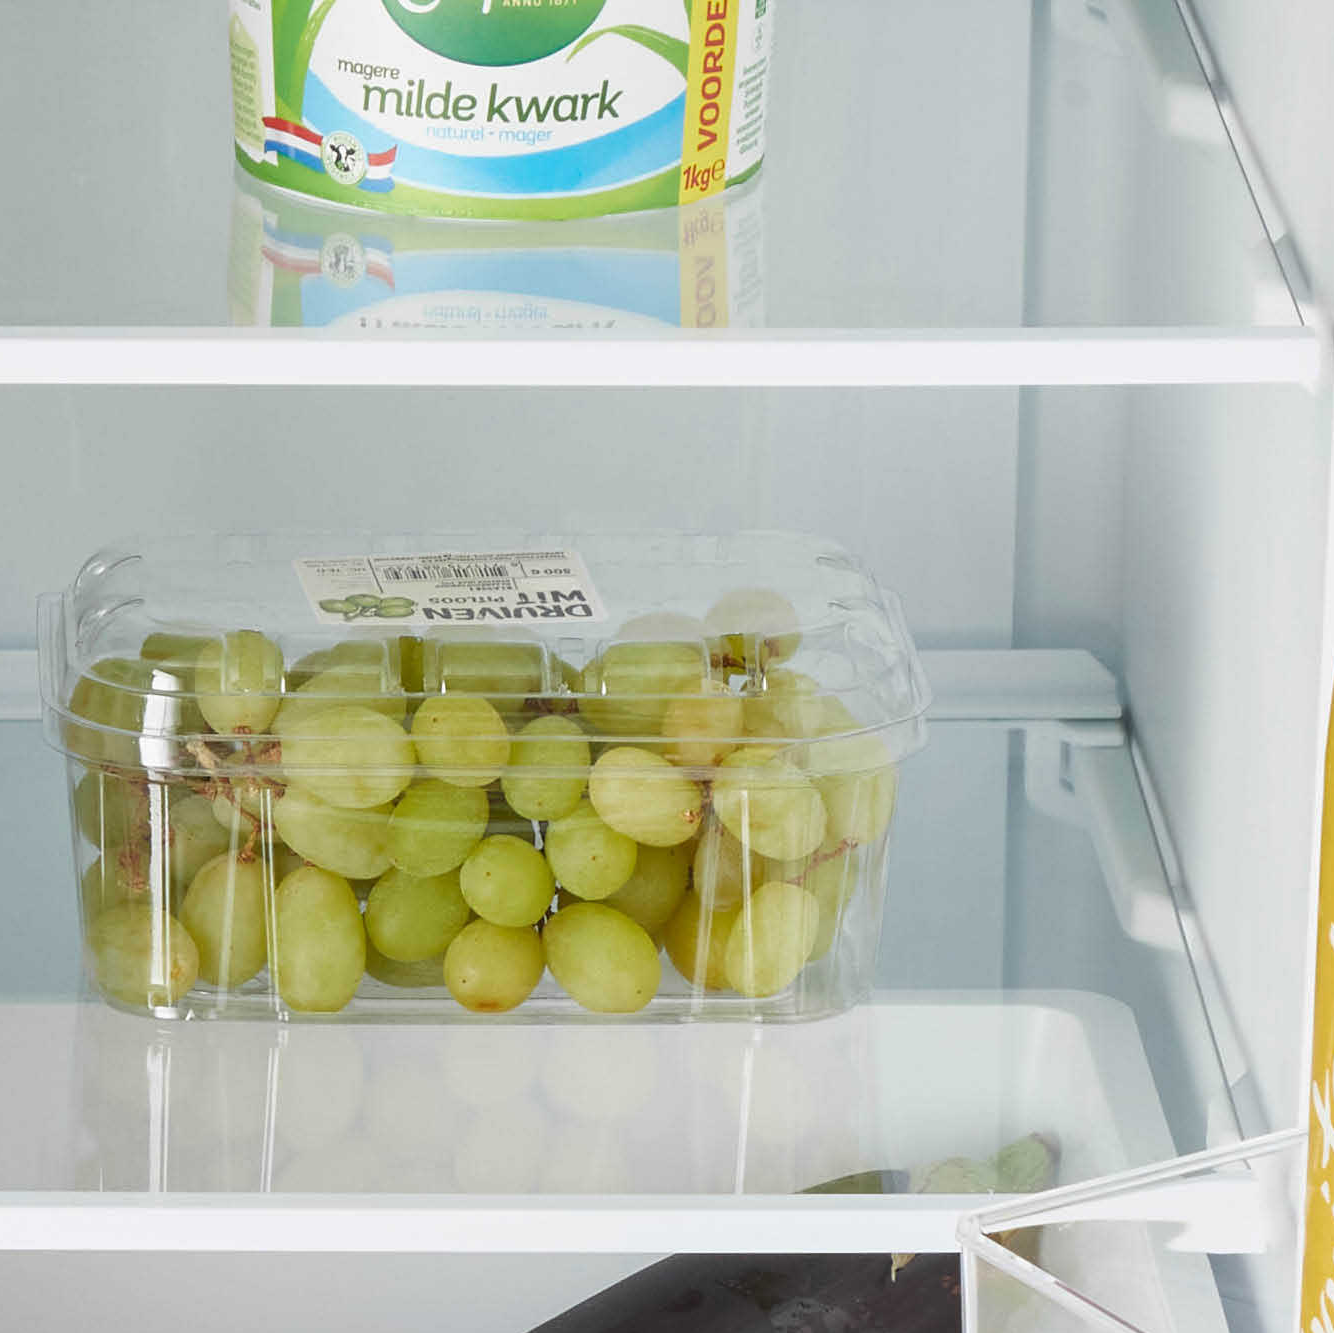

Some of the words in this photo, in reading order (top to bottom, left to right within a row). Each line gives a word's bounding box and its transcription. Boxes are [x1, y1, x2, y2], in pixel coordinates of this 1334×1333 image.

[337, 56, 401, 81] magere
[362, 79, 477, 122] milde
[486, 79, 624, 123] kwark
[426, 125, 484, 142] naturel
[499, 126, 553, 146] mager
[516, 589, 587, 606] WIT
[422, 604, 593, 621] DRUIVEN
